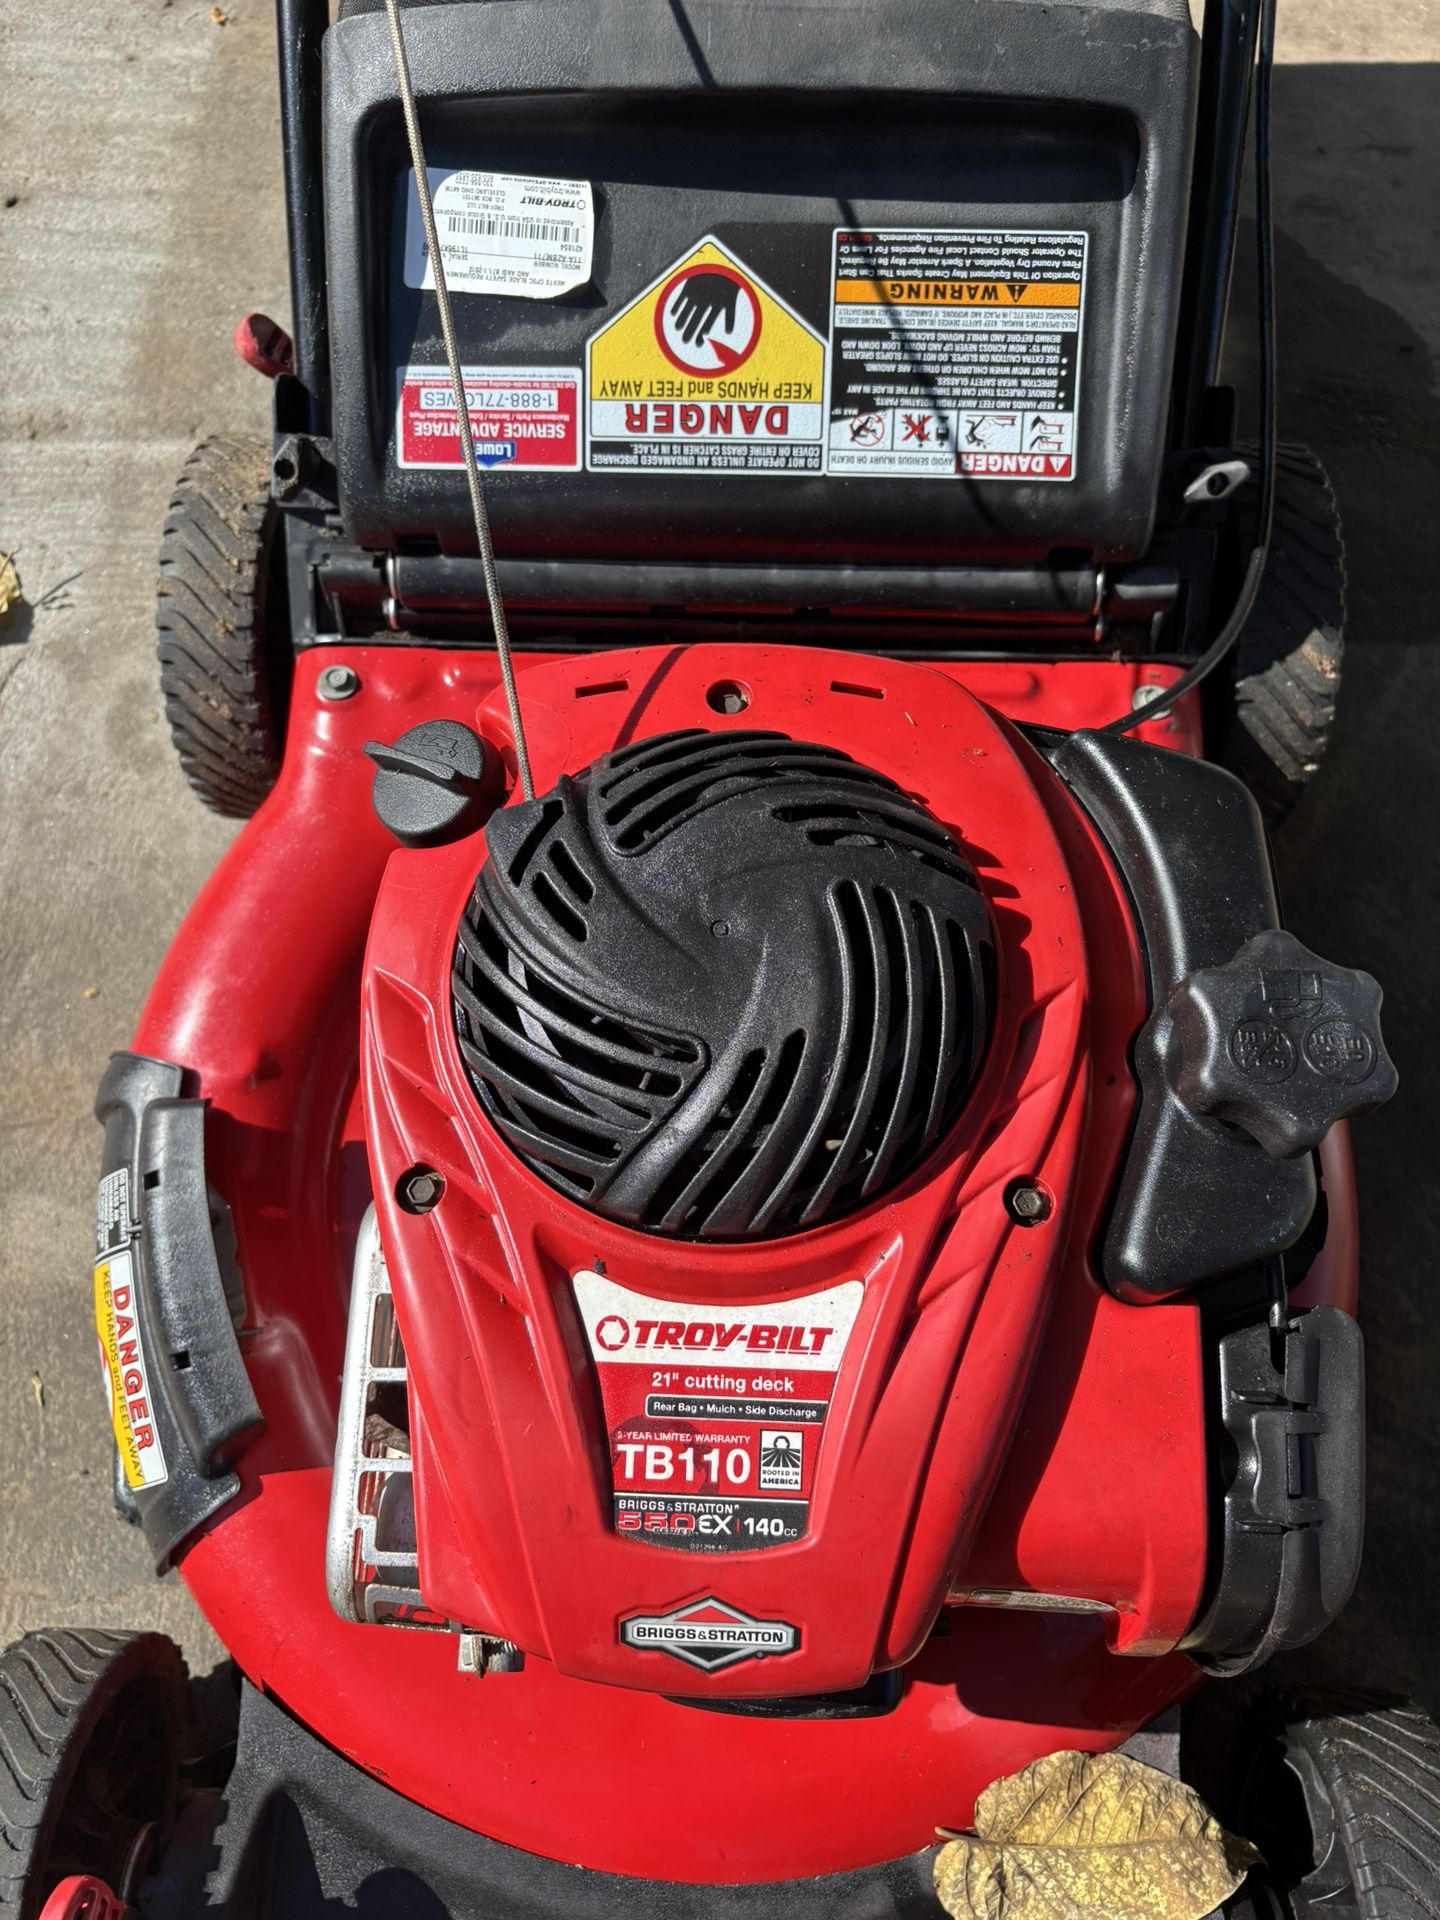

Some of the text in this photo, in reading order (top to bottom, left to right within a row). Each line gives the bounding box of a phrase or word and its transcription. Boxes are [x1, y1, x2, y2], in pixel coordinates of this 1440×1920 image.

[519, 196, 575, 208] TROY-BILT
[877, 233, 932, 243] Requirements.
[933, 235, 975, 243] Prevention
[977, 235, 992, 243] Fire
[1004, 234, 1037, 244] Relating
[1038, 235, 1084, 245] Regulations
[839, 245, 850, 253] Or
[874, 246, 889, 254] For
[890, 244, 927, 254] Agencies
[946, 247, 968, 255] Local
[969, 247, 1000, 255] Contact
[1002, 248, 1030, 256] Should
[1031, 247, 1066, 257] Operator
[1067, 249, 1083, 257] The
[877, 257, 889, 266] Be
[890, 256, 907, 266] May
[908, 258, 939, 266] Arrestor
[940, 257, 964, 267] Spark
[965, 259, 971, 267] A
[973, 257, 1015, 267] Vegetation.
[1016, 258, 1031, 268] Dry
[1032, 260, 1061, 268] Around
[838, 268, 1080, 281] Operation Of This Equipment May Create Sparks Can Start
[889, 283, 999, 301] WARNING
[937, 333, 1061, 343] BEHIND BEFORE AND WHILE MOVING
[858, 341, 880, 349] DOWN
[927, 343, 943, 351] AND
[954, 343, 977, 351] NEVER
[978, 344, 1007, 352] ACROSS
[1008, 344, 1027, 352] MOW
[1041, 345, 1060, 353] THAN
[842, 351, 1060, 364] USE EXTRA CAUTION ON SLOPES. DO NOT SLOPES GREATER
[863, 363, 1058, 376] DO NOT MOW WHEN CHILDREN ARE AROUND.
[935, 377, 968, 386] GLASSES.
[969, 378, 996, 386] SAFETY
[997, 379, 1018, 387] WEAR
[599, 380, 812, 400] KEEP HANDS and FEET AWAY
[846, 385, 862, 393] ANY
[895, 386, 908, 394] THE
[962, 388, 976, 397] CAN
[977, 389, 995, 397] THAT
[996, 389, 1026, 397] OBJECTS
[1027, 390, 1057, 398] REMOVE
[873, 398, 1056, 410] KEEP HANDS AND FEET AWAY PARTS.
[625, 403, 789, 436] DANGER
[413, 422, 566, 439] SERVICE ADVNTAGE
[630, 444, 820, 457] COVER OR ENTIRE GRASS CATCHER IS IN PLACE.
[592, 454, 820, 468] DO NOT OPERATE UNLESS AN UNDAMAGED DISCHARGE
[831, 455, 953, 466] AVOID SERIOUS INJURY OR DEATH
[960, 454, 1045, 473] DANGER
[634, 1320, 834, 1355] TROY-BILT
[113, 1285, 155, 1451] DANGER
[103, 1271, 143, 1478] KEEP HANDS and FEET AWAY
[651, 1371, 795, 1393] 21" cutting deck
[653, 1402, 817, 1418] Rear Bag Mulch Side Discharge
[617, 1431, 751, 1445] 2-YEAR LIMITED WARRANTY
[616, 1443, 751, 1484] TB110
[636, 1627, 784, 1643] BRIGGS&STRATTON
